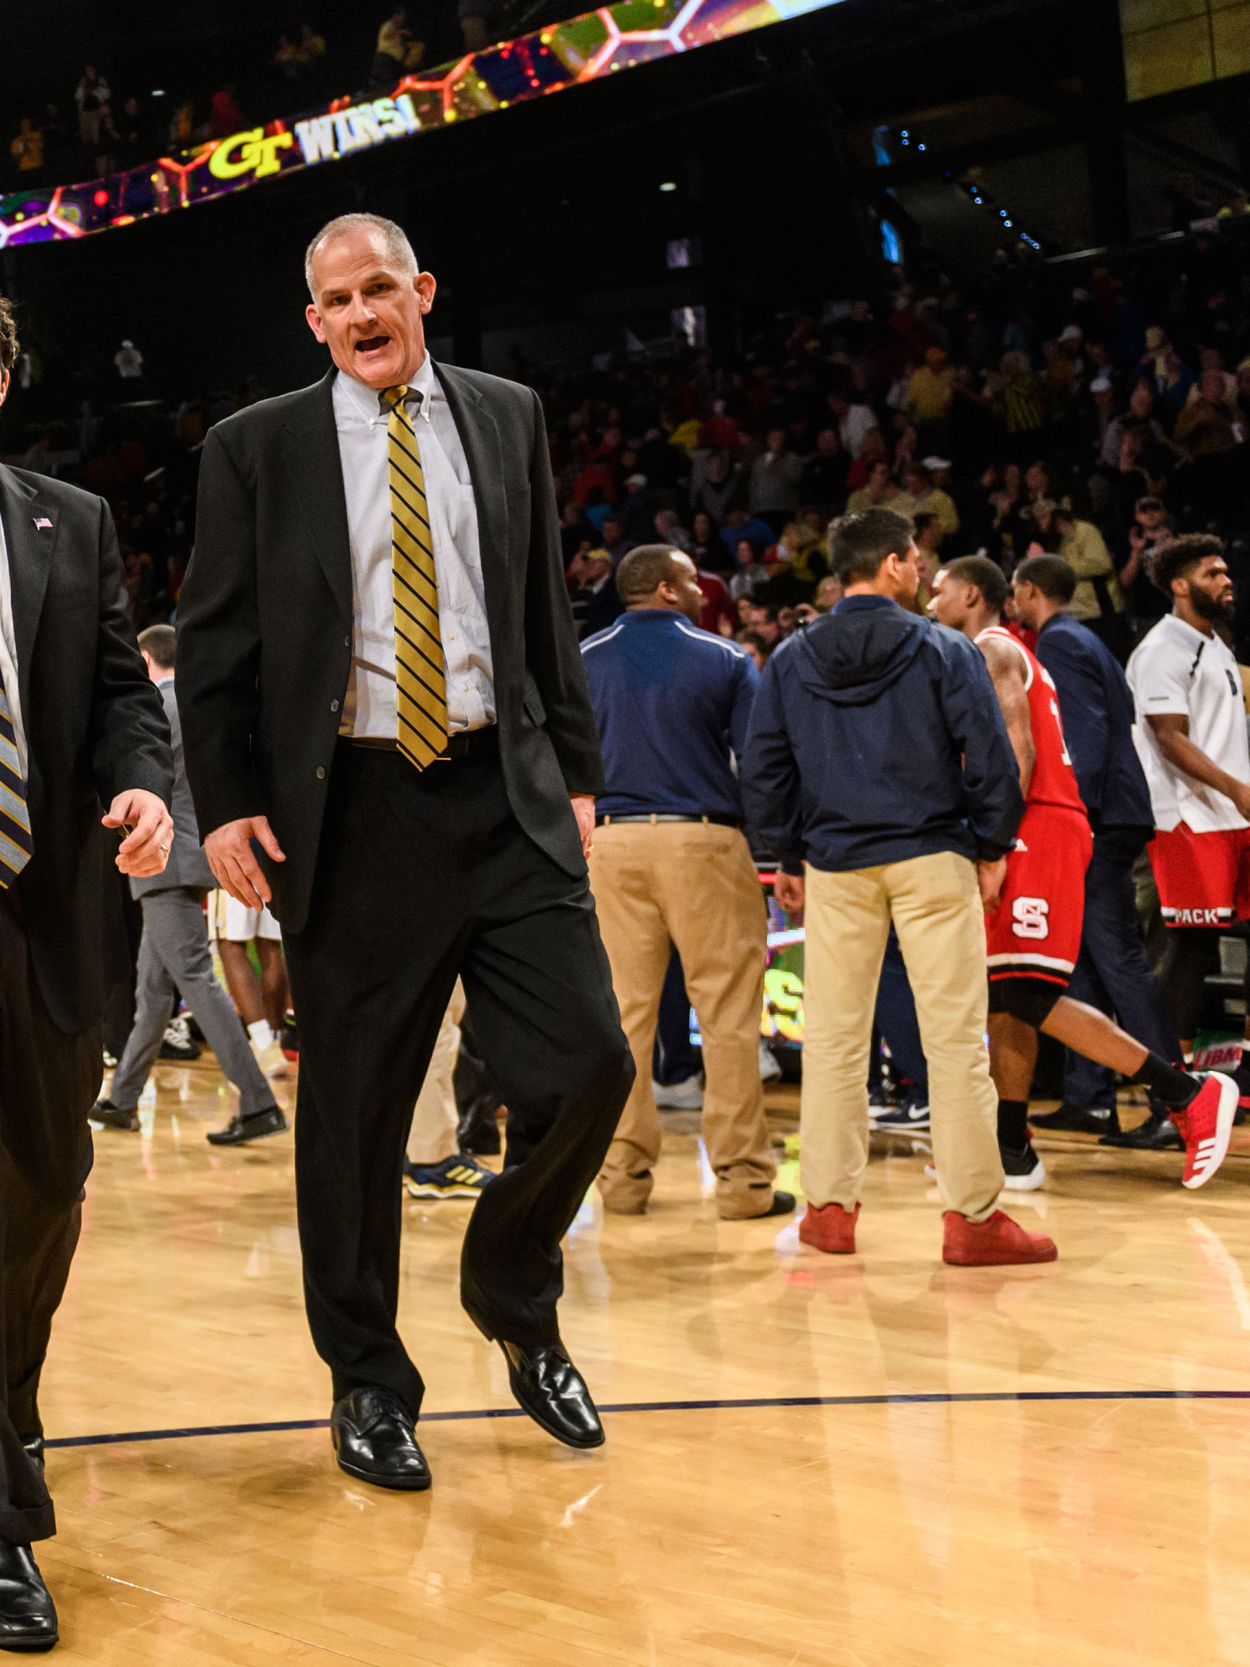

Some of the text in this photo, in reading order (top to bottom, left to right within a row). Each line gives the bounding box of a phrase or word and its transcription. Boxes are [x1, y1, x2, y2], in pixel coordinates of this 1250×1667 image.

[208, 94, 422, 179] GT WINS!
[1175, 908, 1218, 924] PACK
